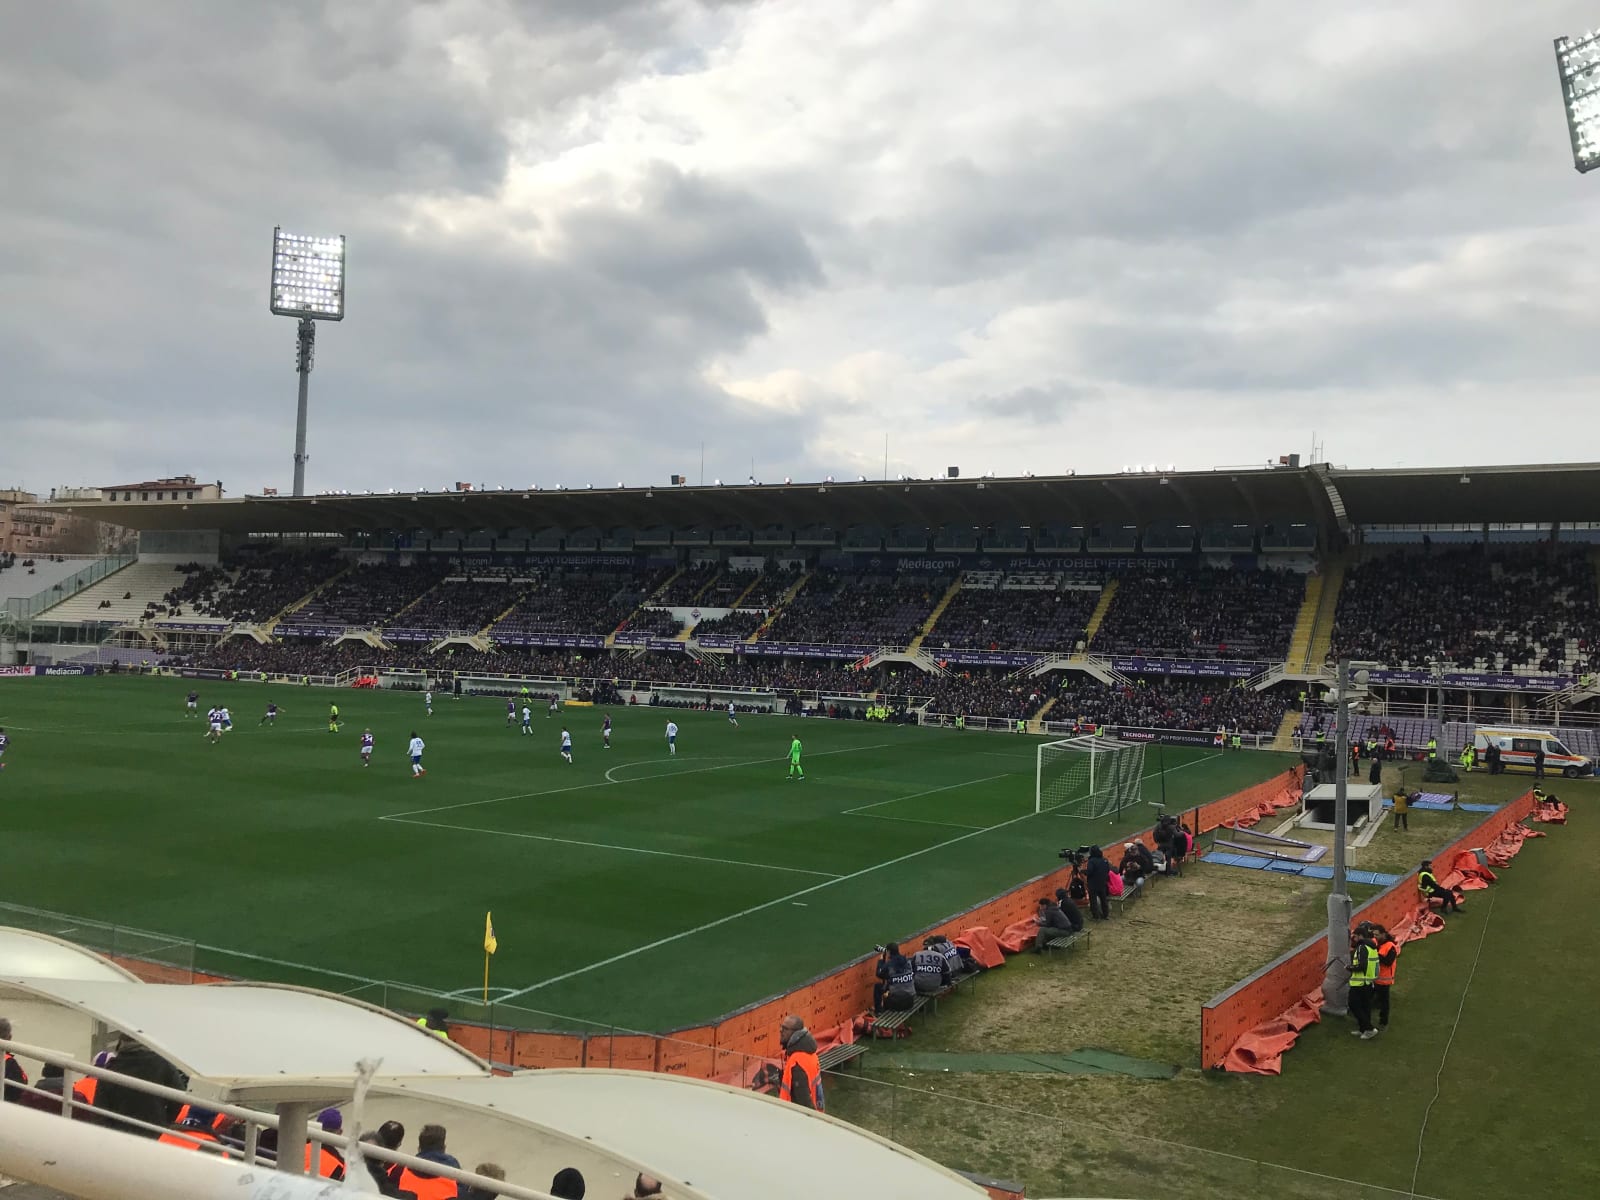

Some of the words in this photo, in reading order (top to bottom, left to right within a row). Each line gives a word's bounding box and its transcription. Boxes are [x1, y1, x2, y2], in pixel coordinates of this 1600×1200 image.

[448, 556, 489, 566] Mecom
[898, 556, 954, 569] Mediacom
[45, 667, 81, 675] Mediacom
[1122, 731, 1155, 739] TECNOMAT
[919, 954, 941, 964] 139
[916, 965, 942, 973] PHOTO
